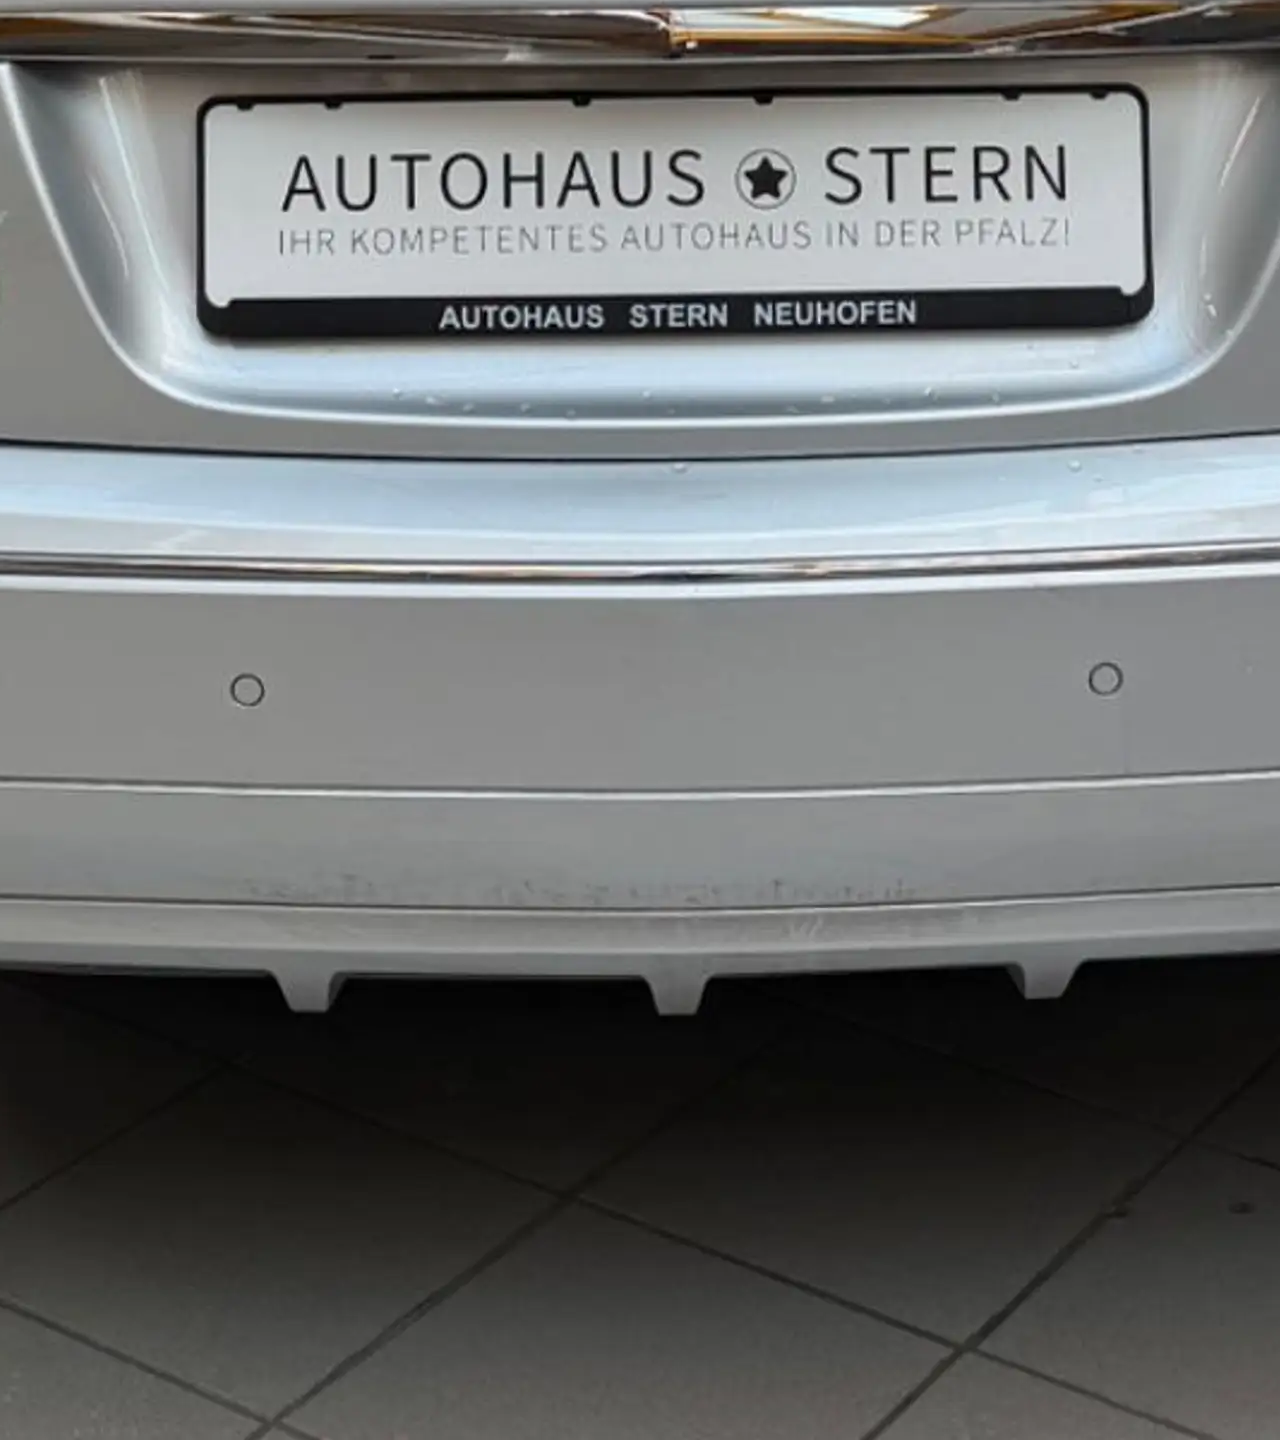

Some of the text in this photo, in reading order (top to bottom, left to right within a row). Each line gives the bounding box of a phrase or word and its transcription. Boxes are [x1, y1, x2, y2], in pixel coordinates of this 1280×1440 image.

[281, 144, 1068, 212] AUTOHAUS STERN
[278, 217, 1070, 256] IHR KOMPETENTES AUTOHAUS IN DER PFALZ!
[438, 299, 917, 330] AUTOHAUS STERN NEUHOFEN
